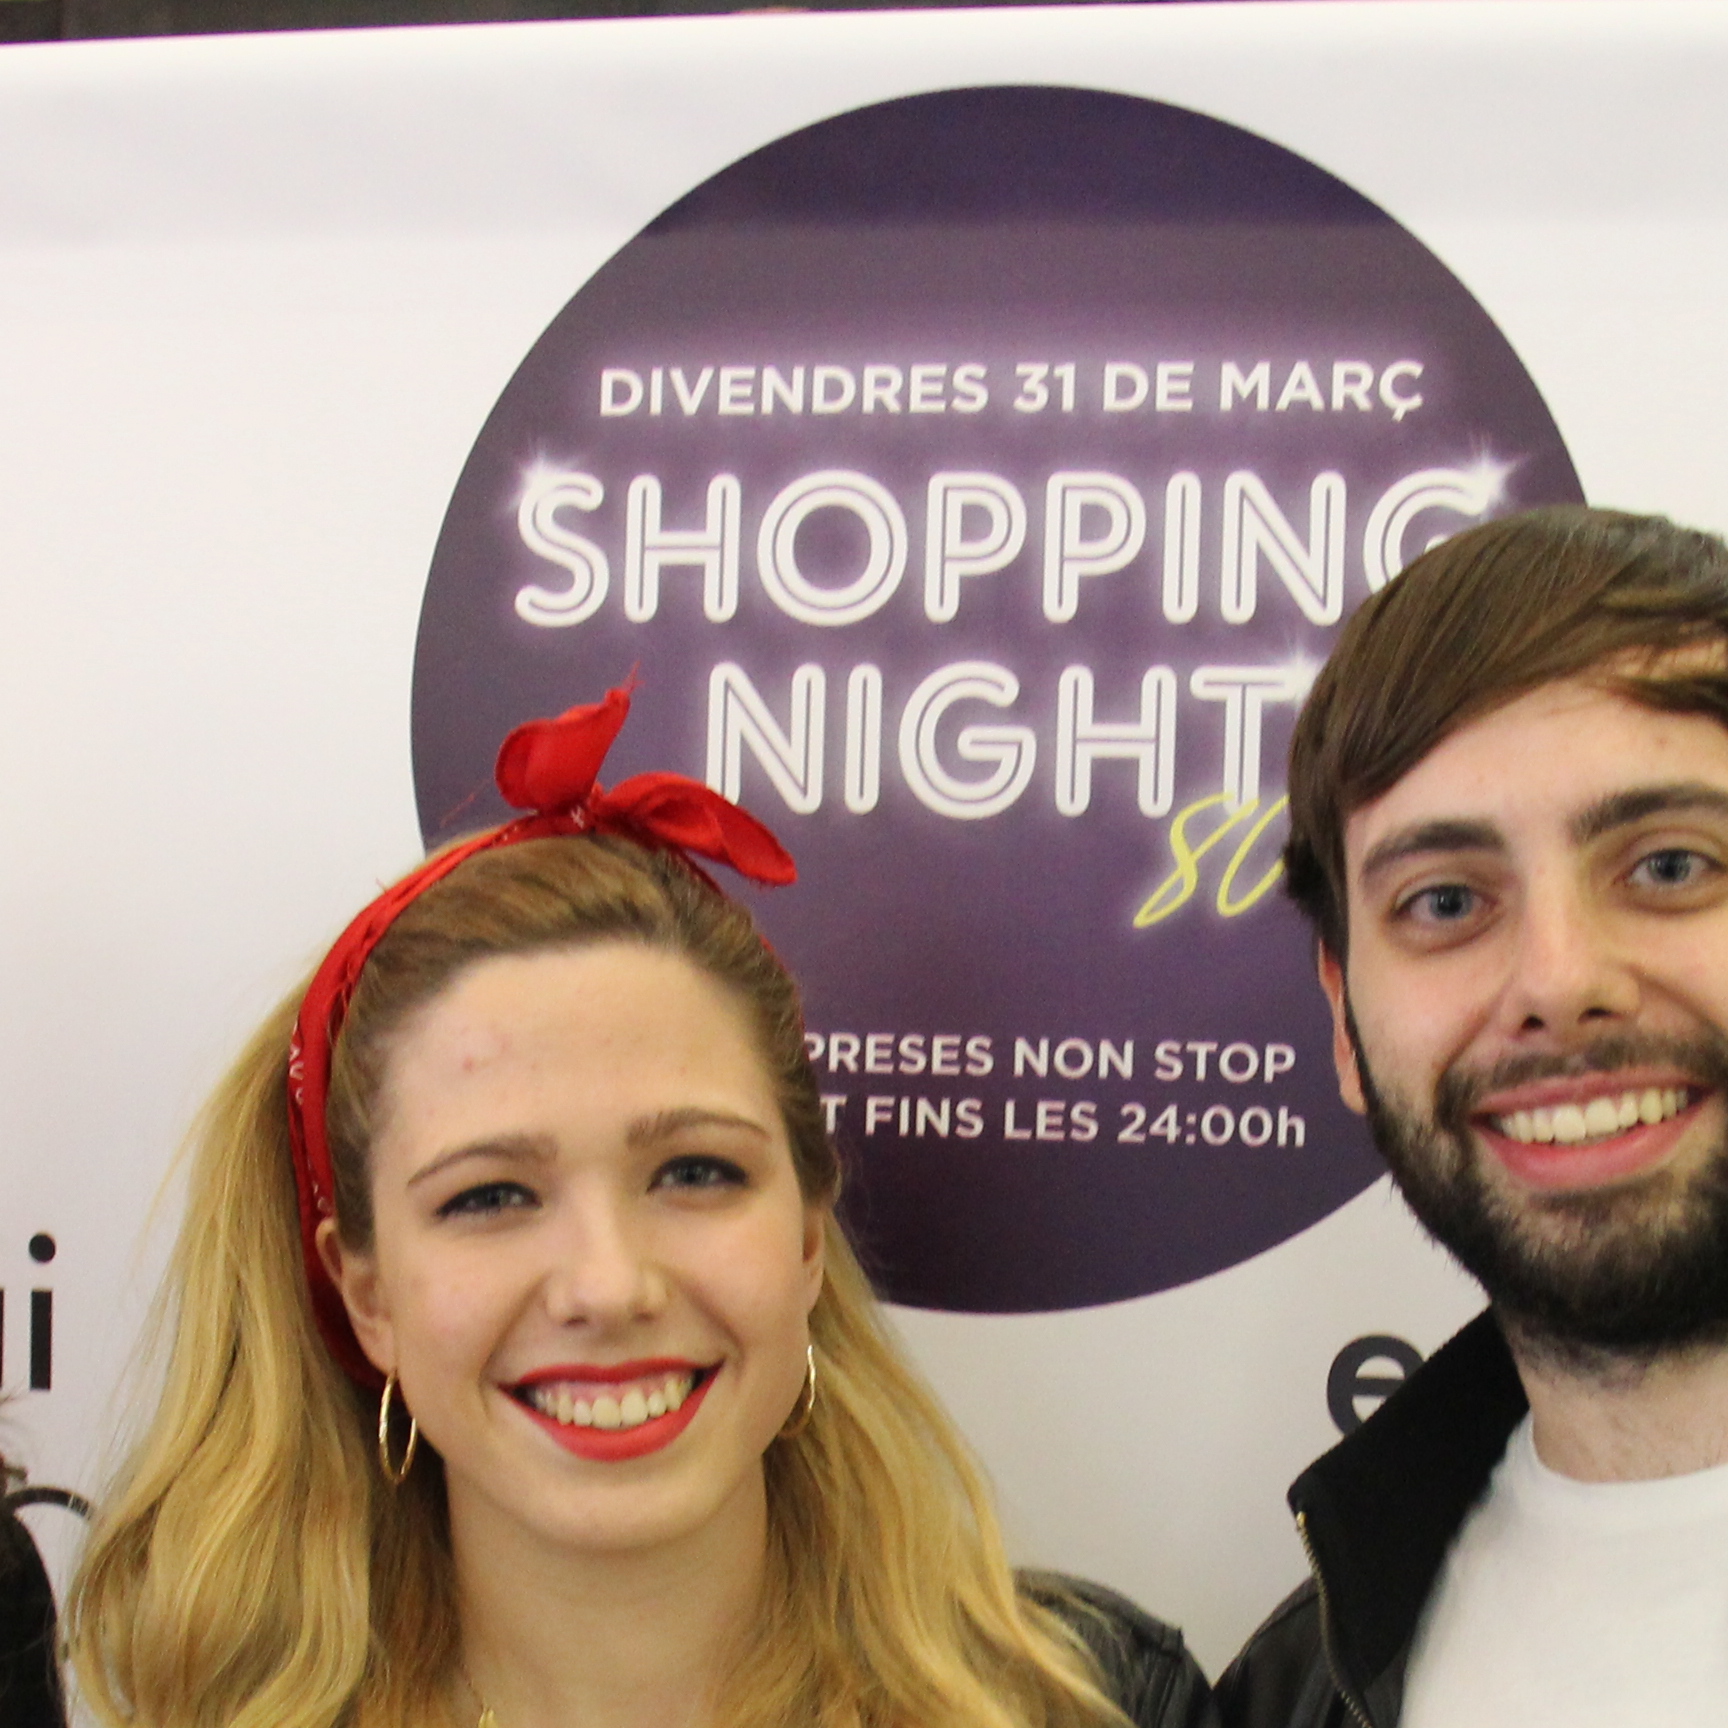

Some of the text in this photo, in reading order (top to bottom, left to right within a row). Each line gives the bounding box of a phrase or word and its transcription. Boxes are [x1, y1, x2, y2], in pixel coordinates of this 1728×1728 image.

[600, 359, 1425, 421] DIVENDRES 31 DE MARÇ
[707, 661, 1318, 820] NIGHT
[804, 1031, 1296, 1084] PRESES NON STOP
[864, 1096, 985, 1139] FINS
[1003, 1099, 1099, 1141] LES
[1117, 1103, 1307, 1149] 24:00h
